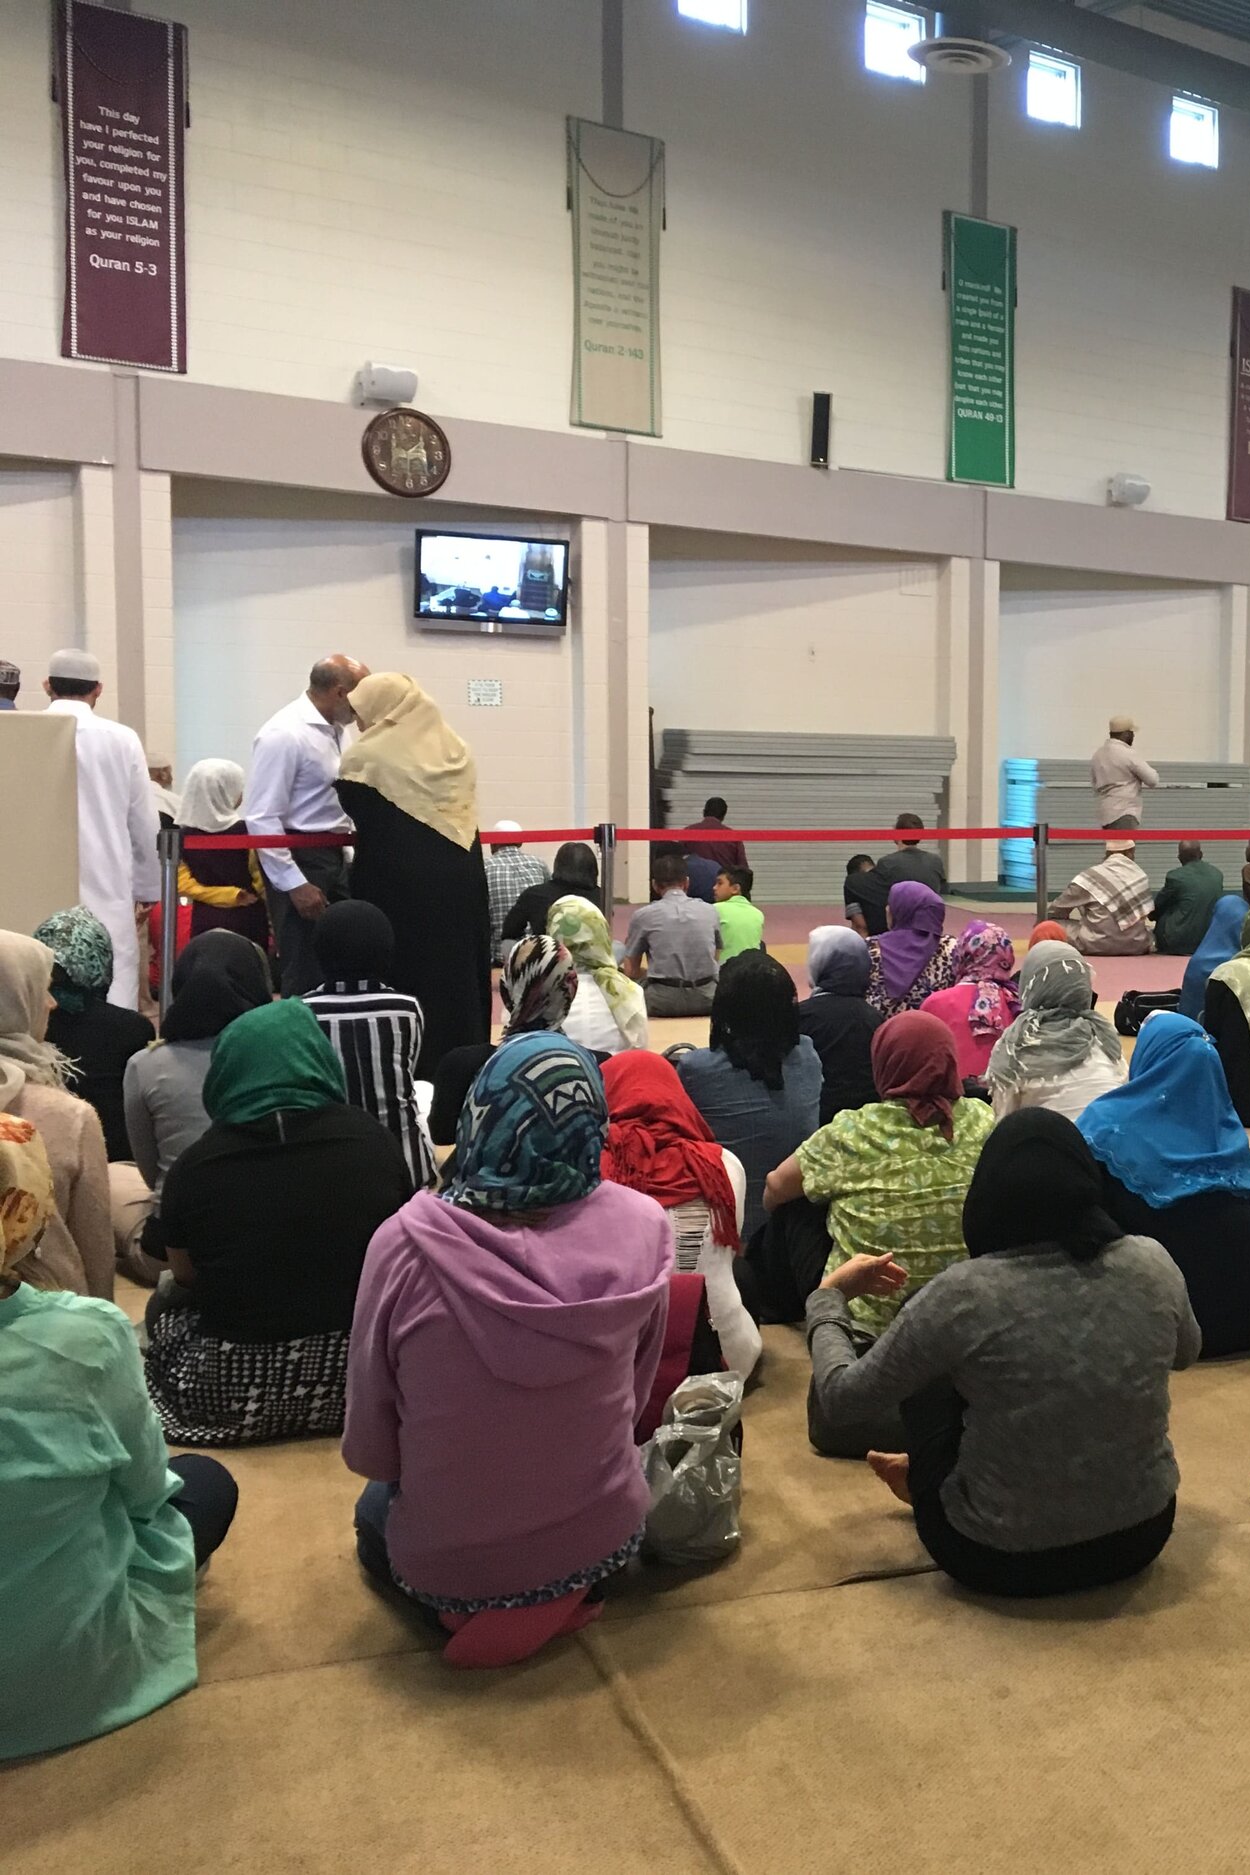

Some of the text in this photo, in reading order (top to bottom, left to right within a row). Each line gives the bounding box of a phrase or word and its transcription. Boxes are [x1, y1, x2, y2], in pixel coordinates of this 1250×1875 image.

[98, 105, 140, 125] This day
[80, 120, 160, 145] have I perfected
[82, 140, 161, 162] your religion for
[75, 155, 167, 183] you, completed my
[82, 172, 162, 197] favour upon you
[82, 191, 162, 213] and have chosen
[87, 208, 159, 230] for you ISLAM
[85, 227, 160, 248] as your religion
[89, 253, 158, 276] Quran 5-3
[584, 339, 615, 354] Quran
[957, 407, 983, 420] QURAN
